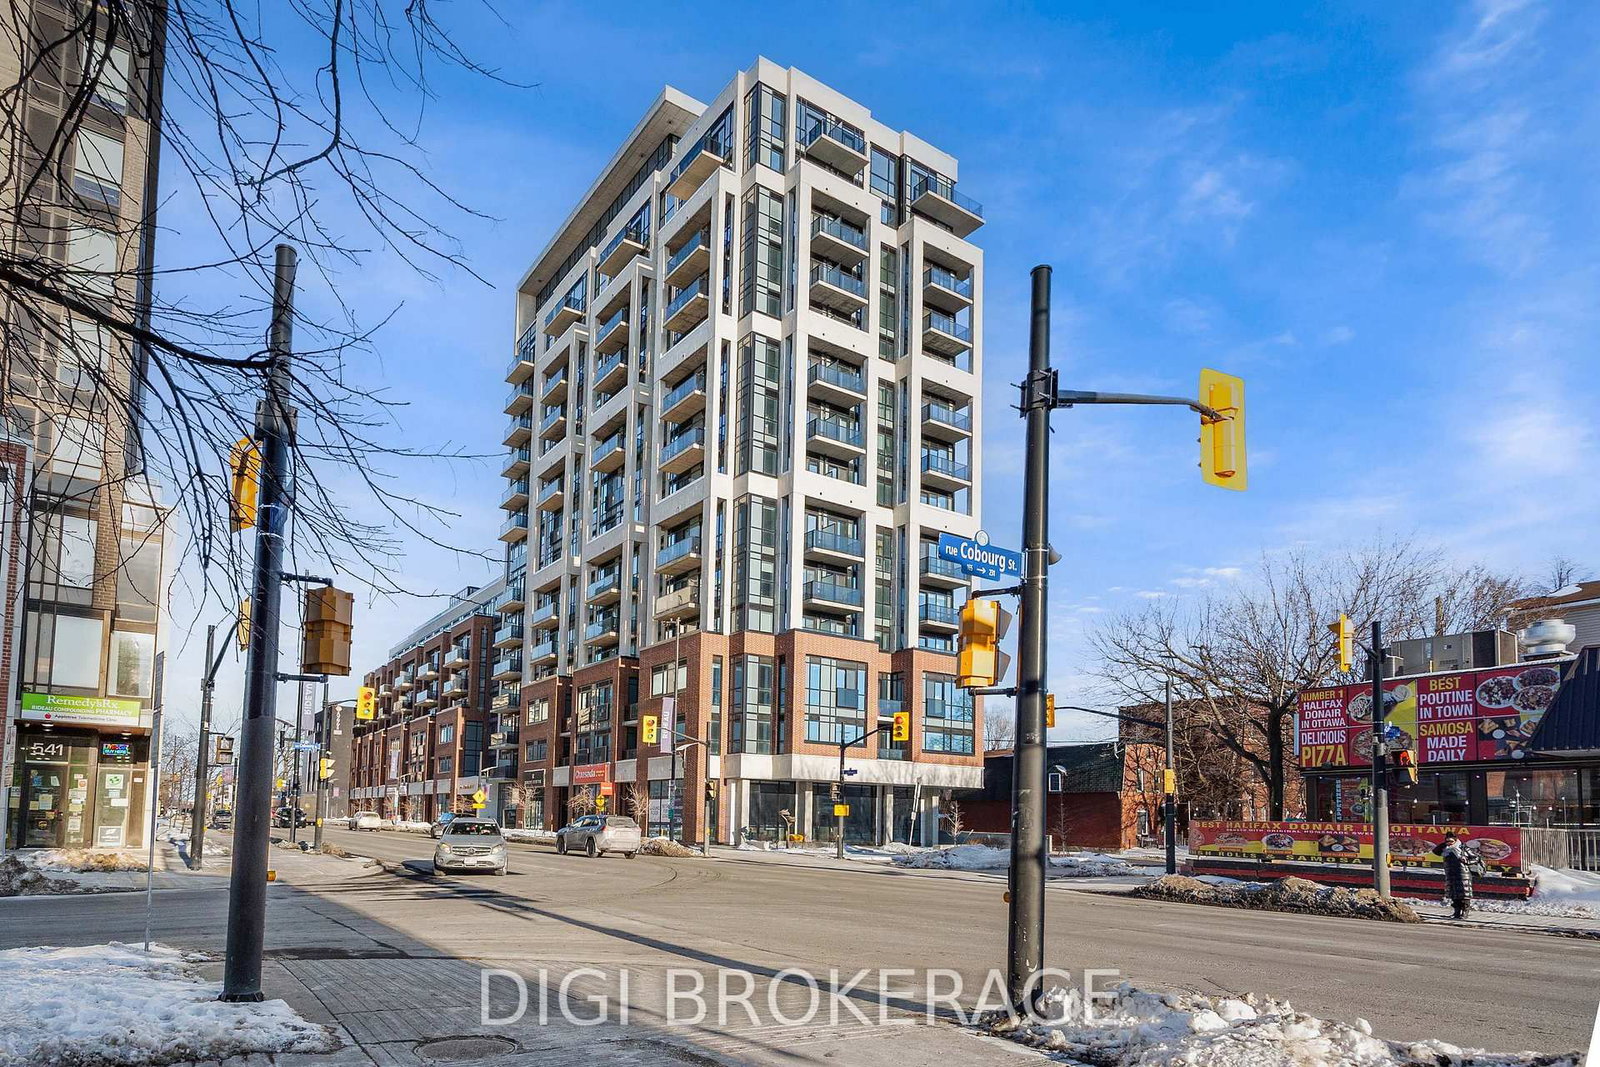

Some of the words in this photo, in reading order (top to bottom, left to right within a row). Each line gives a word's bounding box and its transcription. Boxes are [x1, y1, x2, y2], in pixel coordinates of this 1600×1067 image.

[945, 544, 958, 557] rue
[960, 542, 1006, 572] Cobourg
[1429, 677, 1461, 691] BEST
[1301, 691, 1336, 702] NUMBER
[1338, 689, 1344, 699] 1
[1419, 690, 1473, 705] POUTINE
[1303, 699, 1343, 711] HALIFAX
[1419, 708, 1432, 719] IN
[1436, 704, 1473, 718] TOWN
[1305, 708, 1341, 719] DONAIR
[1301, 720, 1310, 728] IN
[1311, 718, 1346, 728] OTTAWA
[1419, 722, 1474, 736] SAMOSA
[1301, 730, 1346, 745] DELICIOUS
[1427, 736, 1467, 749] MADE
[32, 743, 64, 756] 541
[1302, 745, 1347, 767] PIZZA
[1428, 748, 1467, 762] DAILY
[1226, 822, 1281, 830] HALIFAX
[1289, 822, 1354, 832] DONAIR
[1391, 826, 1470, 835] OTTAWA
[1218, 851, 1257, 859] ROLLS
[1286, 854, 1362, 864] SAMOSA
